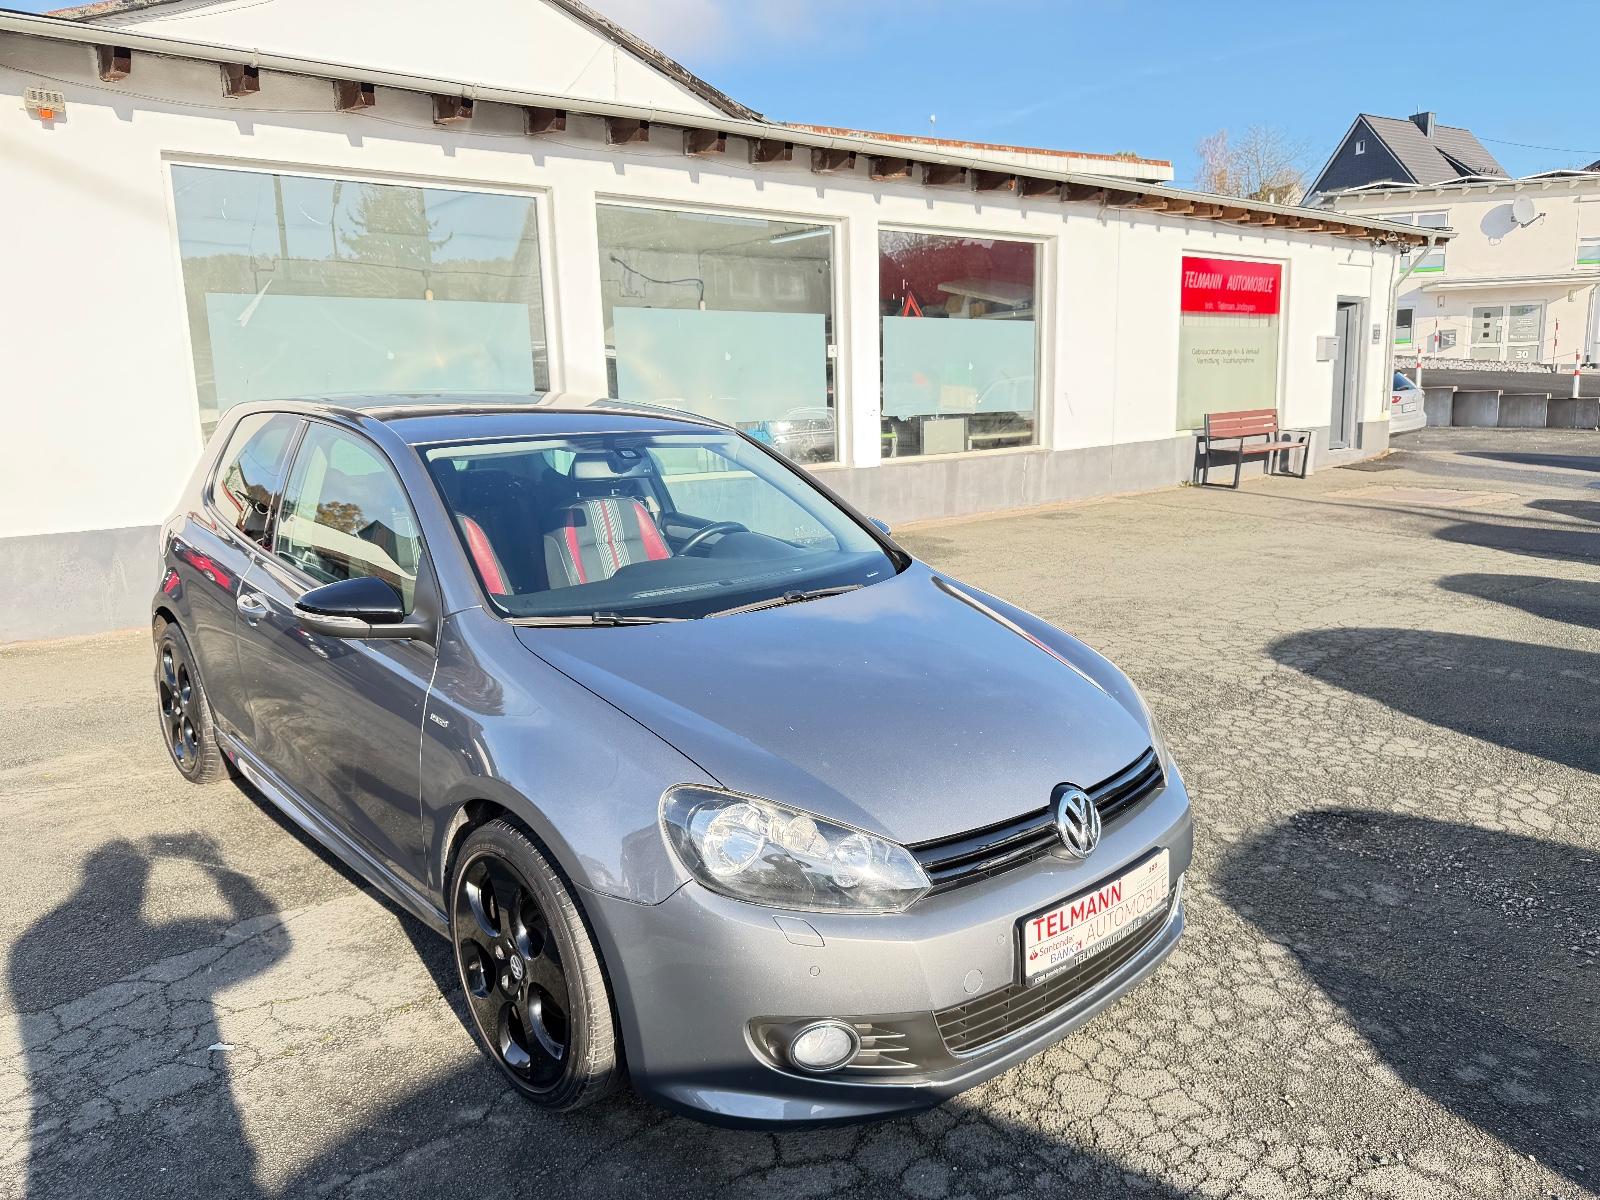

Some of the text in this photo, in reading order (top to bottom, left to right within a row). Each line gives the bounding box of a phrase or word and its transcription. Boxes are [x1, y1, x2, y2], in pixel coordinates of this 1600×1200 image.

[1184, 271, 1274, 293] TELMANN AUTOMOBILE
[1515, 350, 1529, 359] 30
[1033, 882, 1122, 942] TELMANN
[1085, 876, 1168, 944] AUTOMOBILE
